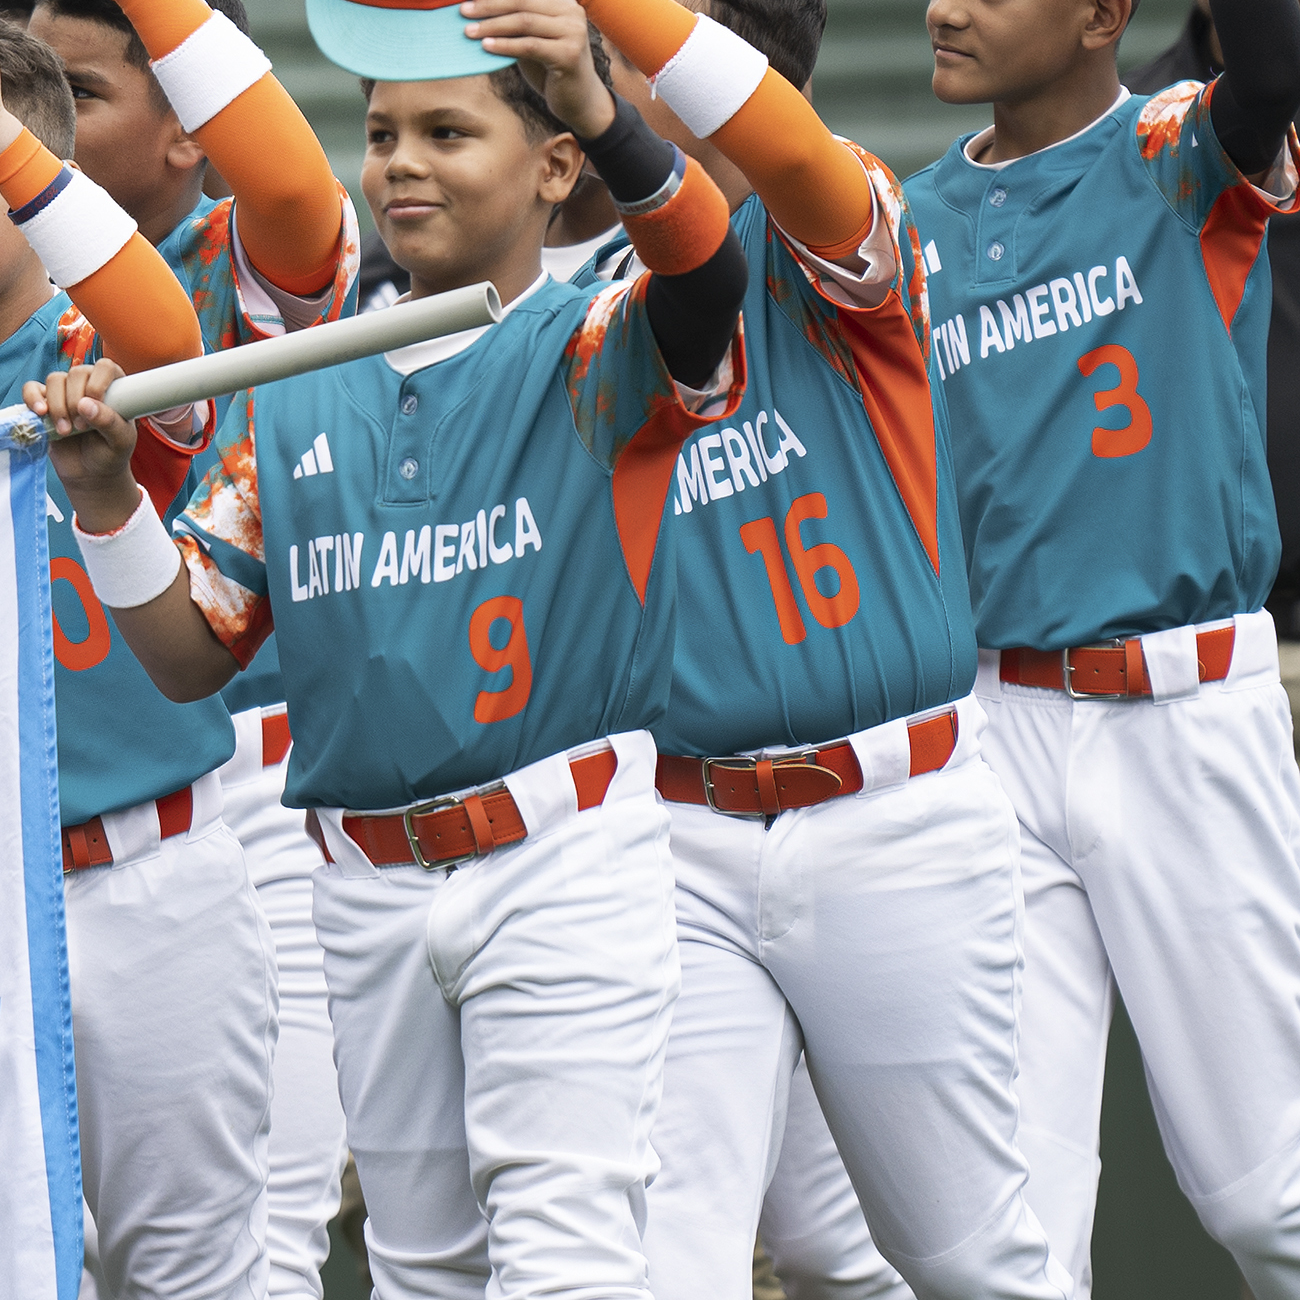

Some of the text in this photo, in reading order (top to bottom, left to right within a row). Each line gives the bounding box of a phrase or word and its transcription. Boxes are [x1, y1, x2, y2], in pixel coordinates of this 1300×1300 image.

[933, 255, 1144, 382] TIN AMERICA
[1077, 344, 1154, 458] 3
[289, 496, 543, 602] LATIN AMERICA
[739, 491, 861, 646] 16
[468, 595, 533, 724] 9
